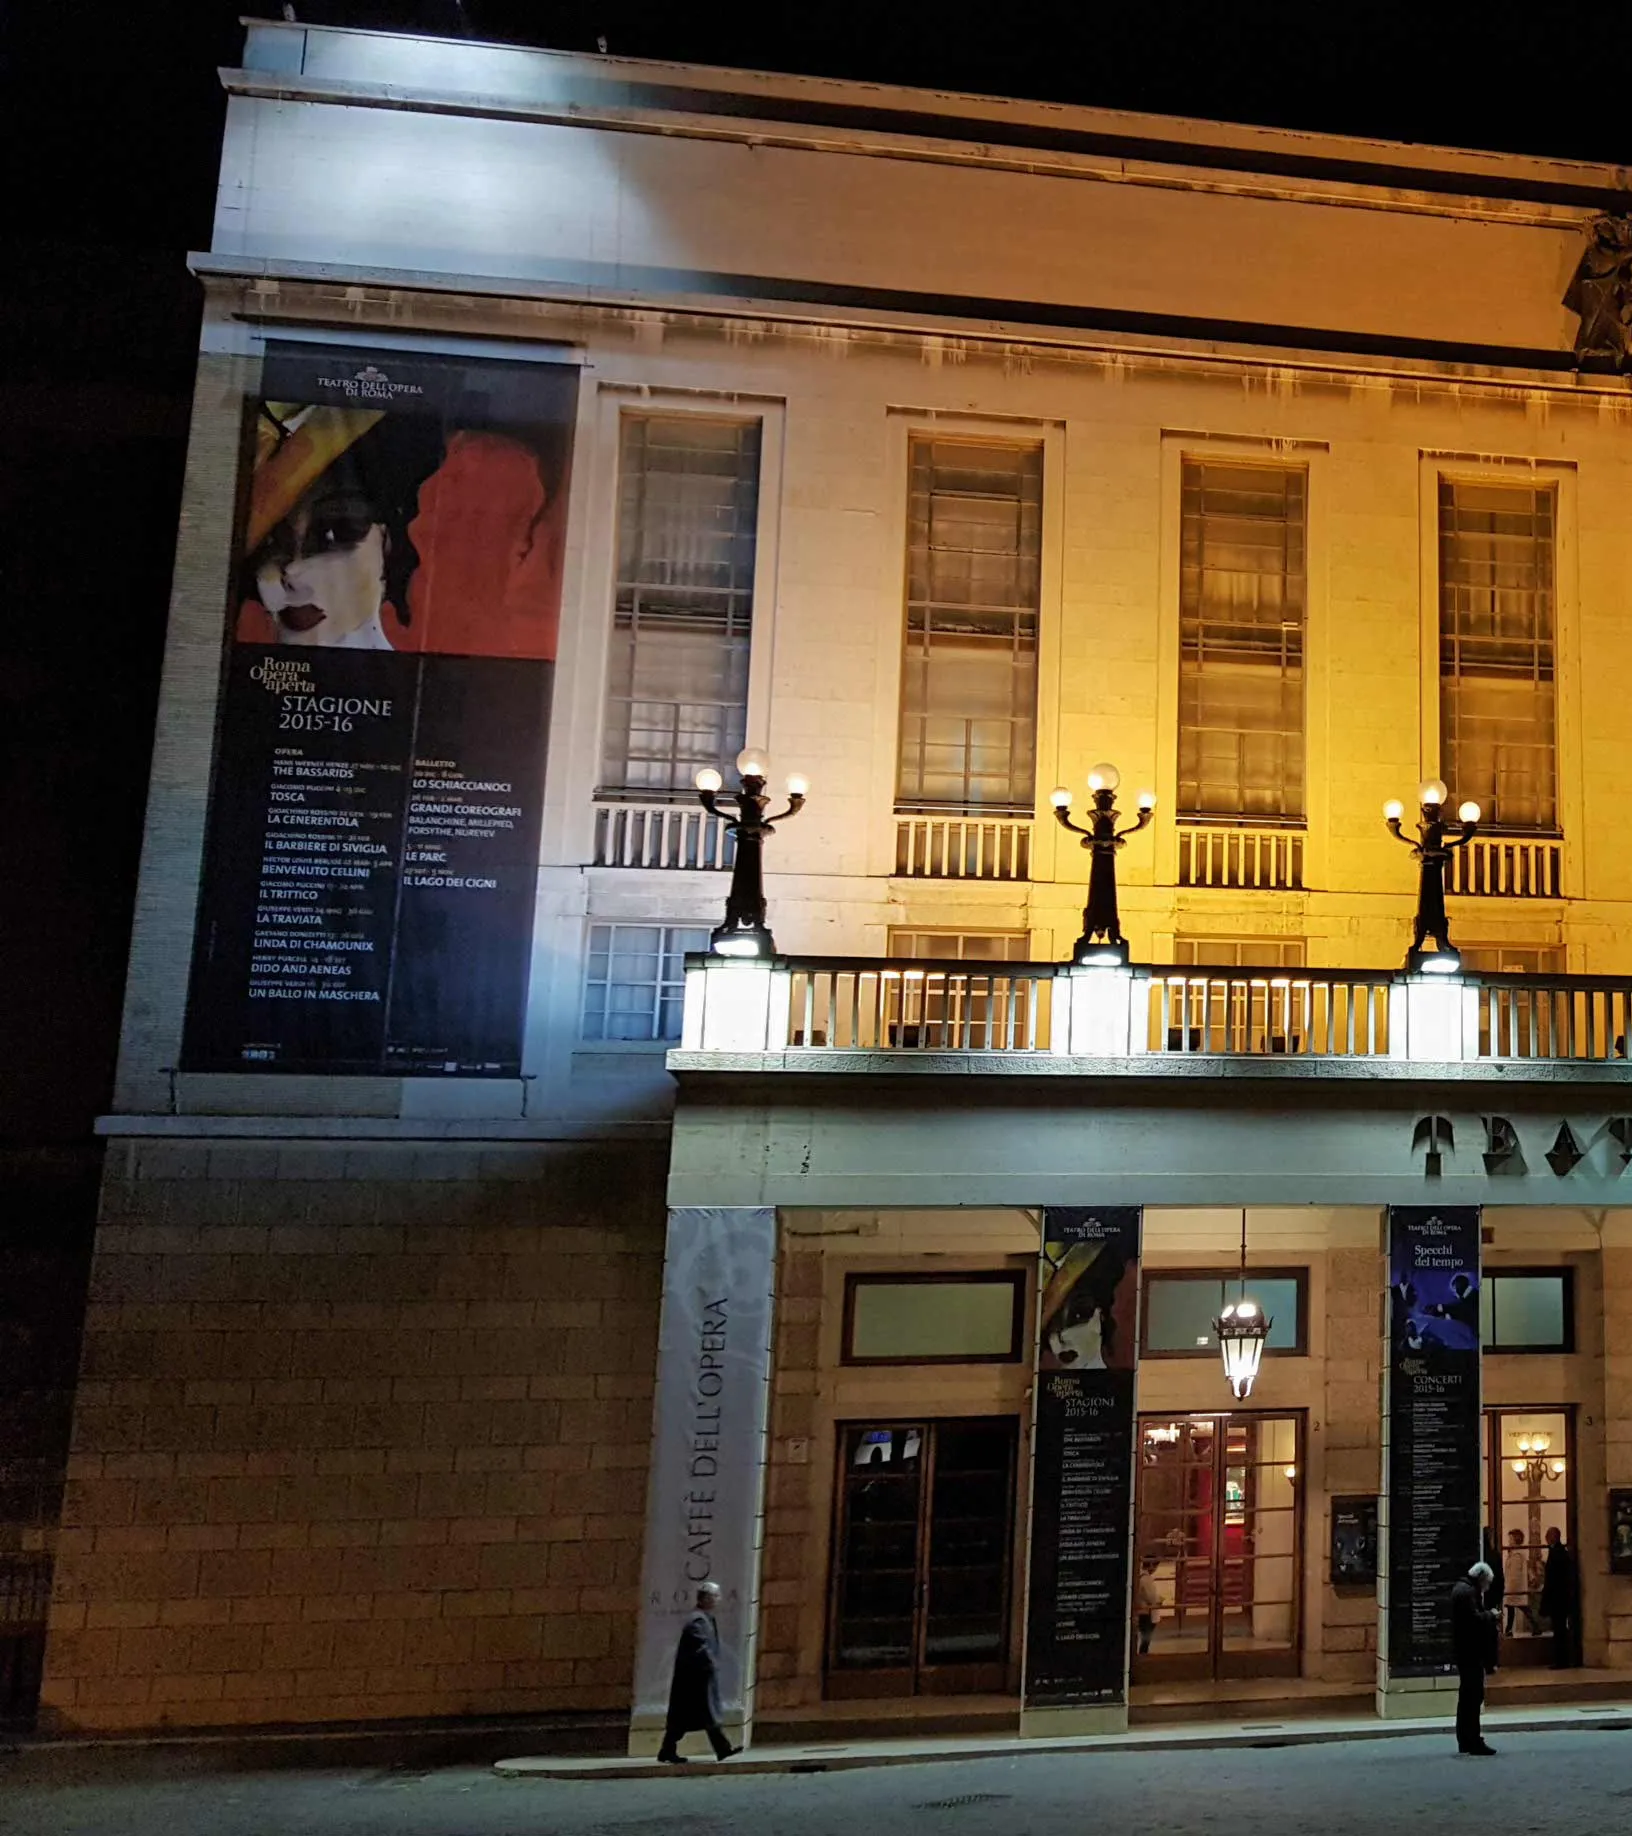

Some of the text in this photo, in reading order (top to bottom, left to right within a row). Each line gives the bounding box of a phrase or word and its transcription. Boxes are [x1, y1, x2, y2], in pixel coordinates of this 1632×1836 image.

[318, 378, 423, 394] TEATRO DELL'OPERA
[345, 388, 393, 399] DI ROMA
[264, 656, 311, 673] Roma
[250, 665, 298, 684] Opera
[265, 678, 316, 694] aperta
[282, 695, 393, 716] STAGIONE
[278, 713, 353, 732] 2015-16
[274, 748, 303, 756] OPERA
[415, 759, 456, 768] BALLETTO
[273, 766, 293, 776] THE
[295, 767, 355, 779] BASSARIDS
[412, 779, 511, 792] LO SCHIACCIANOCI
[271, 791, 305, 802] TOSCA
[410, 803, 522, 817] GRANDI COREOGRAFI
[267, 815, 359, 827] LA CENERENTOLA
[455, 828, 496, 838] NUREYEV
[264, 840, 388, 854] IL BARBIERE DI SIVIGLIA
[405, 851, 447, 862] LE PARC
[262, 864, 370, 878] BENVENUTO CELLINI
[403, 876, 497, 889] IL LAGO DEI CIGNI
[259, 889, 318, 900] IL TRITTICO
[256, 913, 322, 925] LA TRAVIATA
[254, 938, 374, 952] LINDA DI CHAMOUNIX
[251, 963, 352, 976] DIDO AND AENEAS
[248, 988, 380, 1001] UN BALLO IN MASCHERA
[1414, 1244, 1453, 1257] Specchi
[1414, 1255, 1464, 1269] del tempo
[1413, 1375, 1462, 1385] CONCERTI
[684, 1297, 728, 1582] CAFFÈ DELL'OPERA
